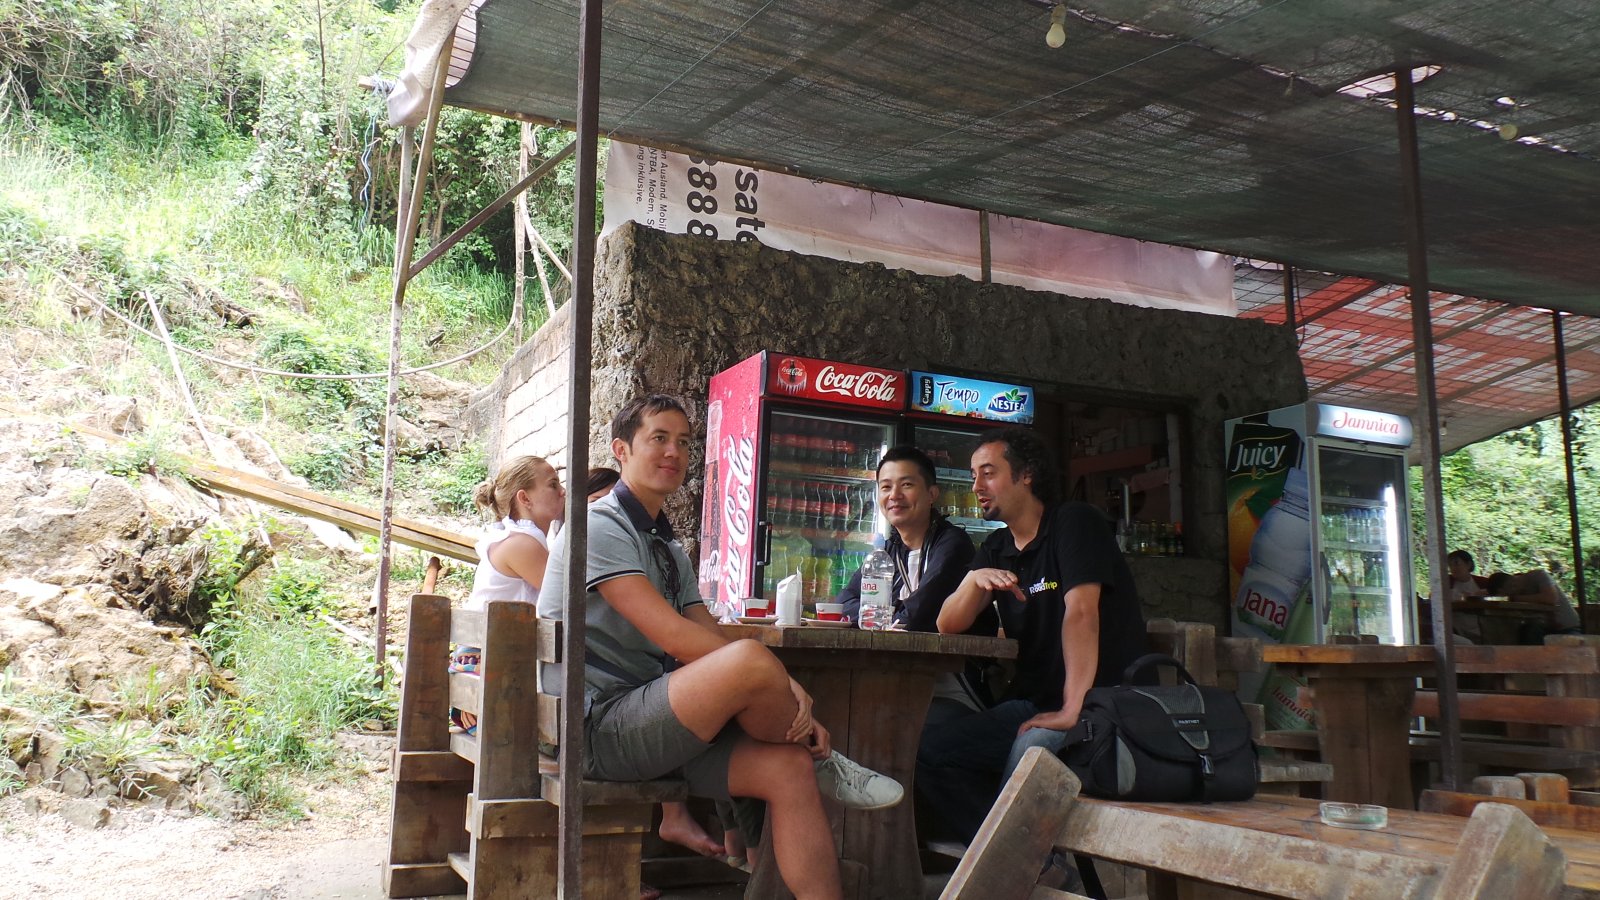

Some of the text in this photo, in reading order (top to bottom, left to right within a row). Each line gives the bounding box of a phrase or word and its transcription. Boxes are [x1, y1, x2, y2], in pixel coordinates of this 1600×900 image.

[660, 162, 668, 200] Ausland,
[646, 178, 656, 214] Modem,
[816, 366, 898, 402] Coca-Cola
[922, 379, 930, 404] Cappy
[936, 382, 979, 408] Tempo
[991, 397, 1026, 412] NESTEA
[1332, 412, 1400, 434] Jamnica
[1231, 442, 1287, 472] Juicy
